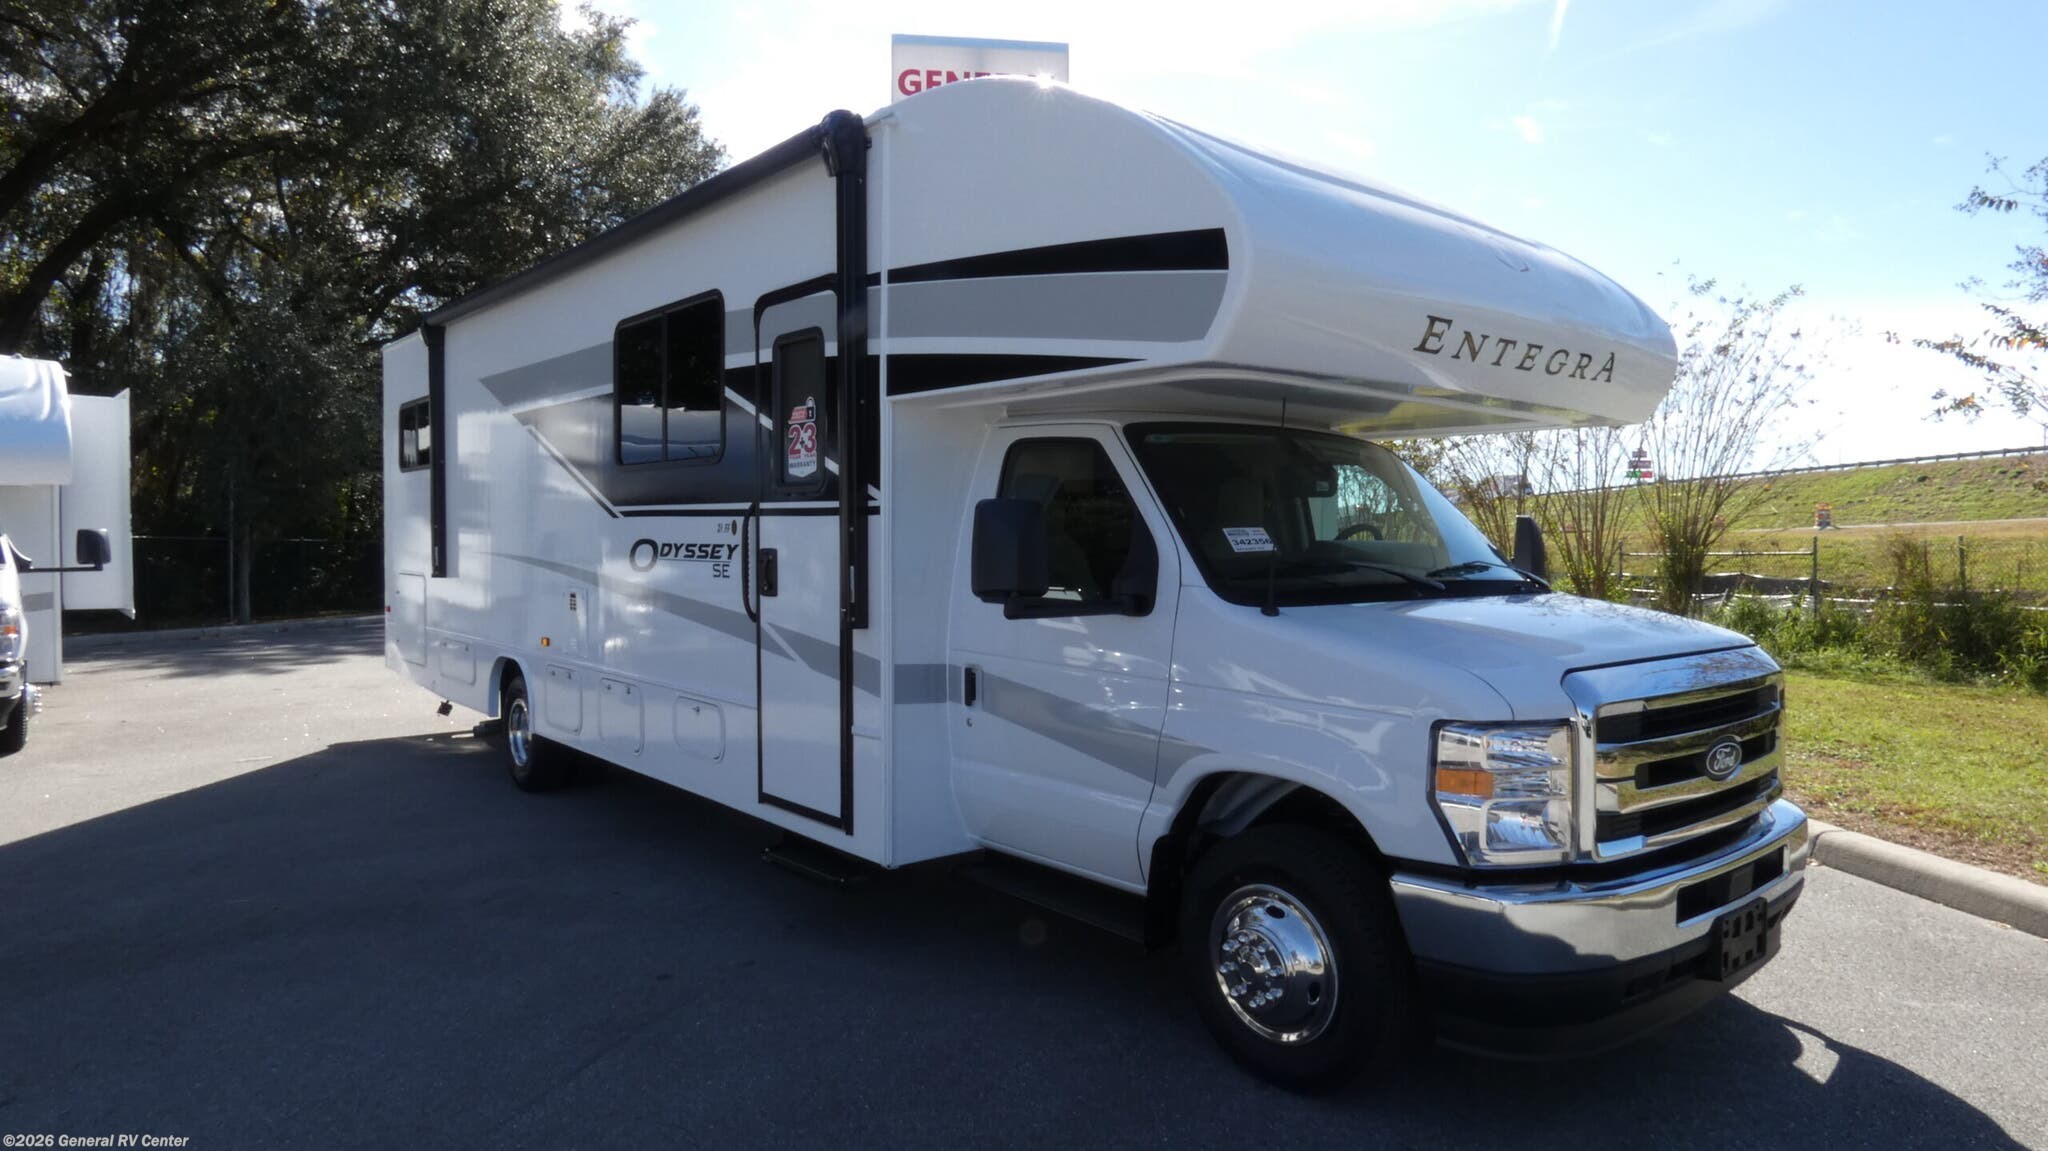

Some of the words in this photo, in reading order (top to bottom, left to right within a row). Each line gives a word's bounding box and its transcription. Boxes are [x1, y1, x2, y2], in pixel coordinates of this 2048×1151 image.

[1413, 315, 1616, 383] ENTEGRA
[629, 538, 739, 572] ODYSSEY
[713, 563, 730, 578] SE
